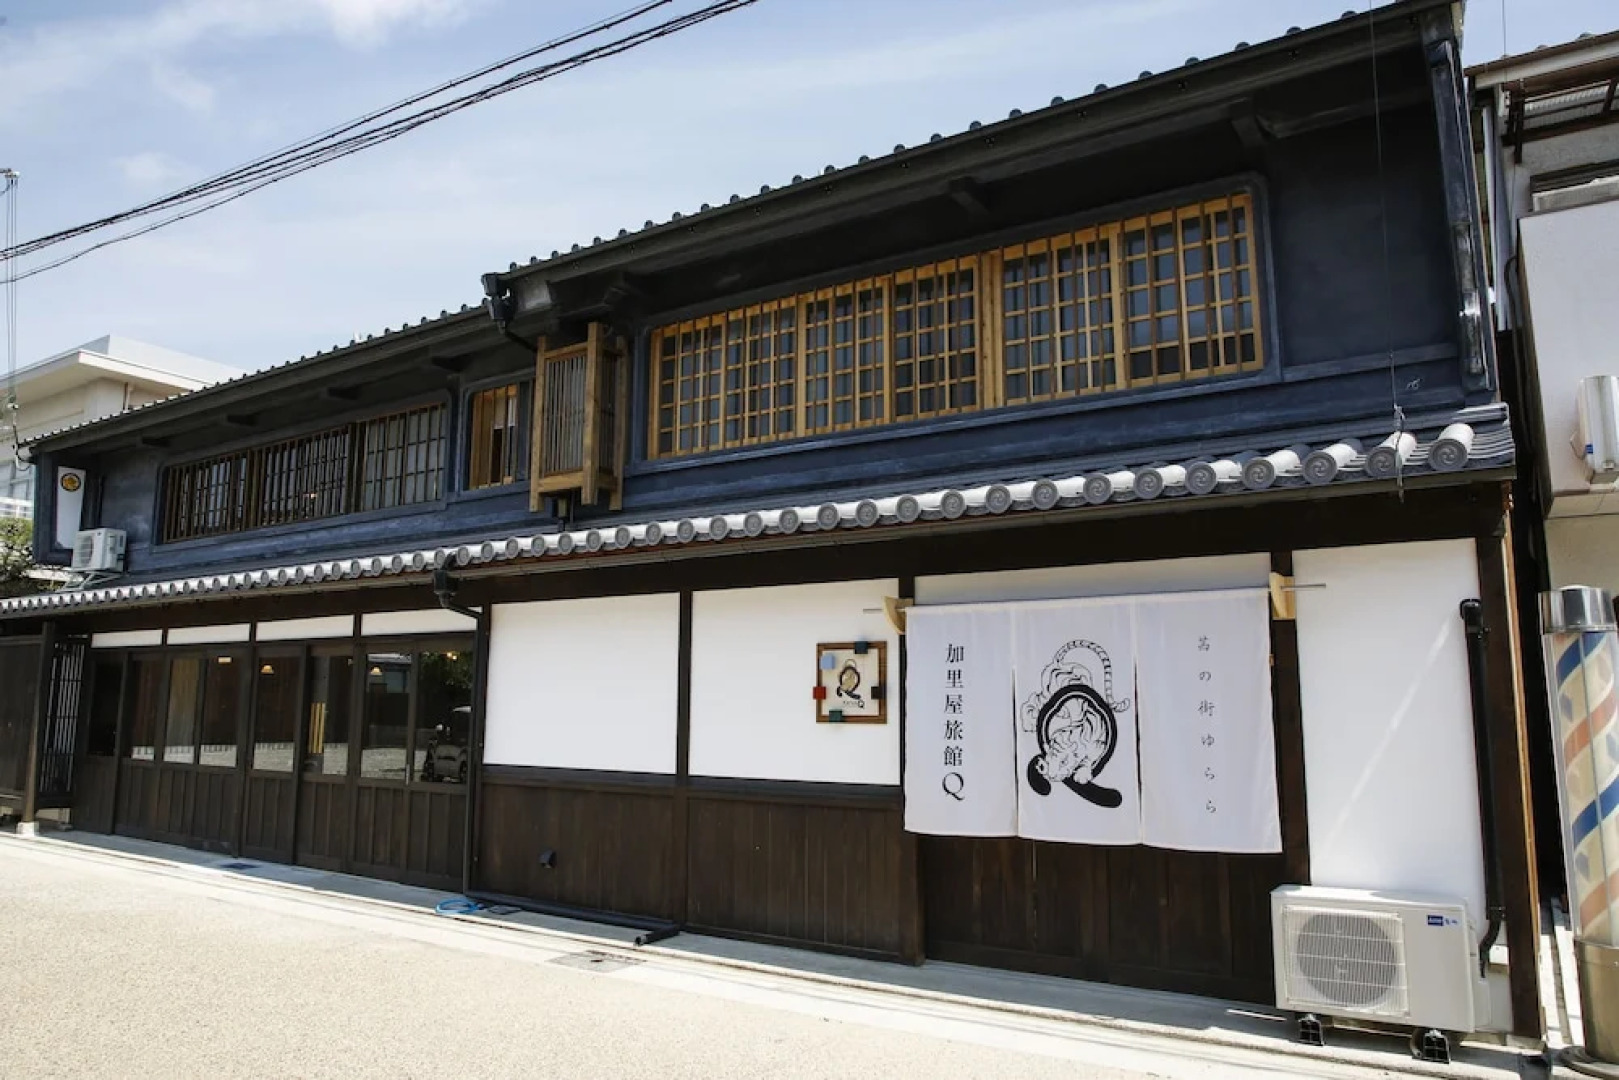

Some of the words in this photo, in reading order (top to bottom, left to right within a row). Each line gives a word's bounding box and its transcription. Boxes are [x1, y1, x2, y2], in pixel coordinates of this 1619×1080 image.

[941, 643, 966, 802] 加里屋旅館Q
